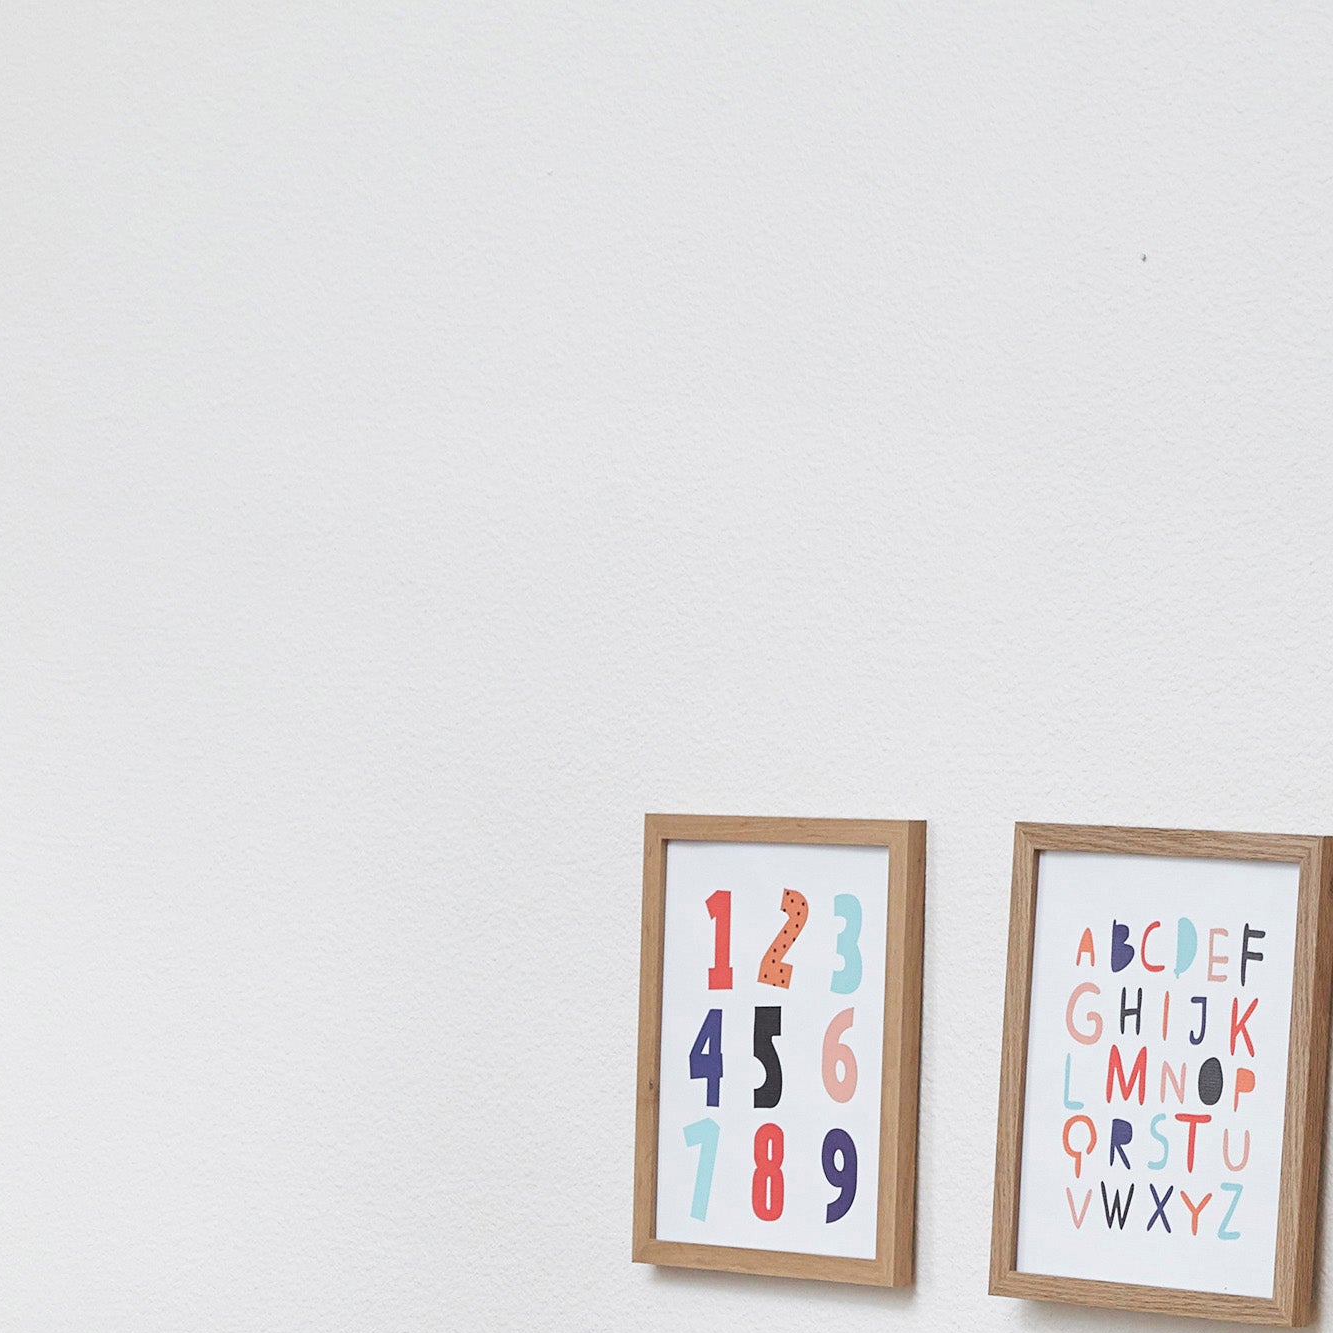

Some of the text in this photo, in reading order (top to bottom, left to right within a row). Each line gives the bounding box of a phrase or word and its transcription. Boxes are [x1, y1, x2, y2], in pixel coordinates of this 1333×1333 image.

[705, 888, 863, 995] 1 2 3
[689, 1006, 858, 1109] 4 5 6
[751, 1122, 785, 1222] 8
[821, 1128, 858, 1224] 9
